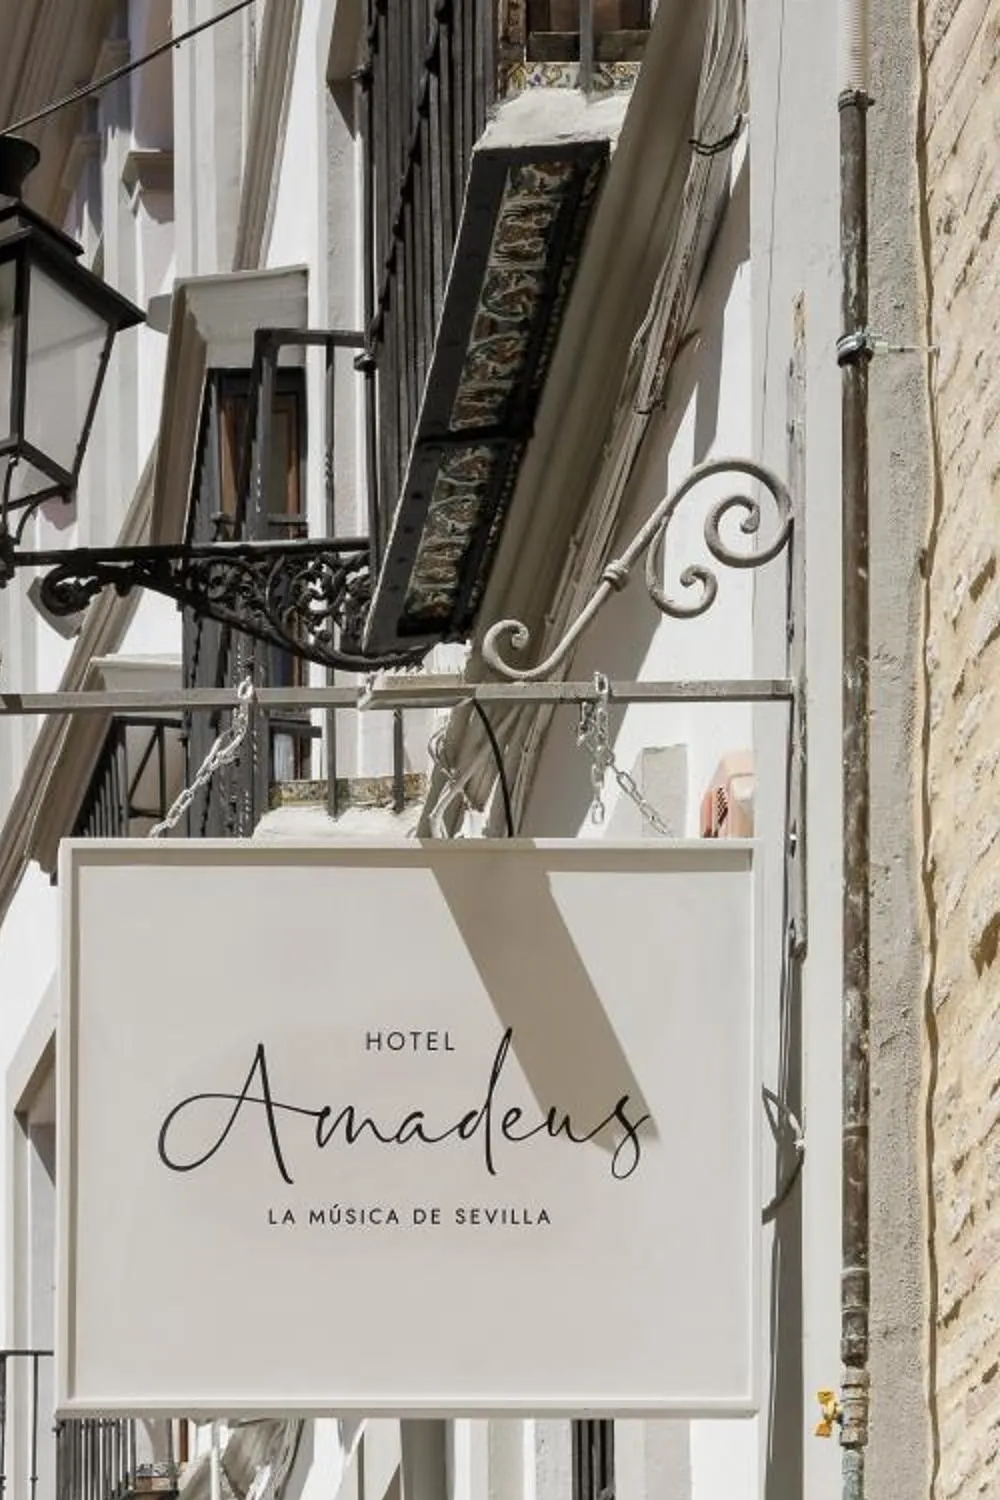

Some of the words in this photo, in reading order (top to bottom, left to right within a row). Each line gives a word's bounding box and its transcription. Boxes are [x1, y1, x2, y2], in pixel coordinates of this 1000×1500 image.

[366, 1031, 456, 1051] HOTEL
[158, 1027, 650, 1184] Amadeus
[268, 1208, 295, 1225] LA
[309, 1203, 399, 1225] MÚSICA
[413, 1208, 441, 1225] DE
[455, 1208, 551, 1225] SEVILLA
